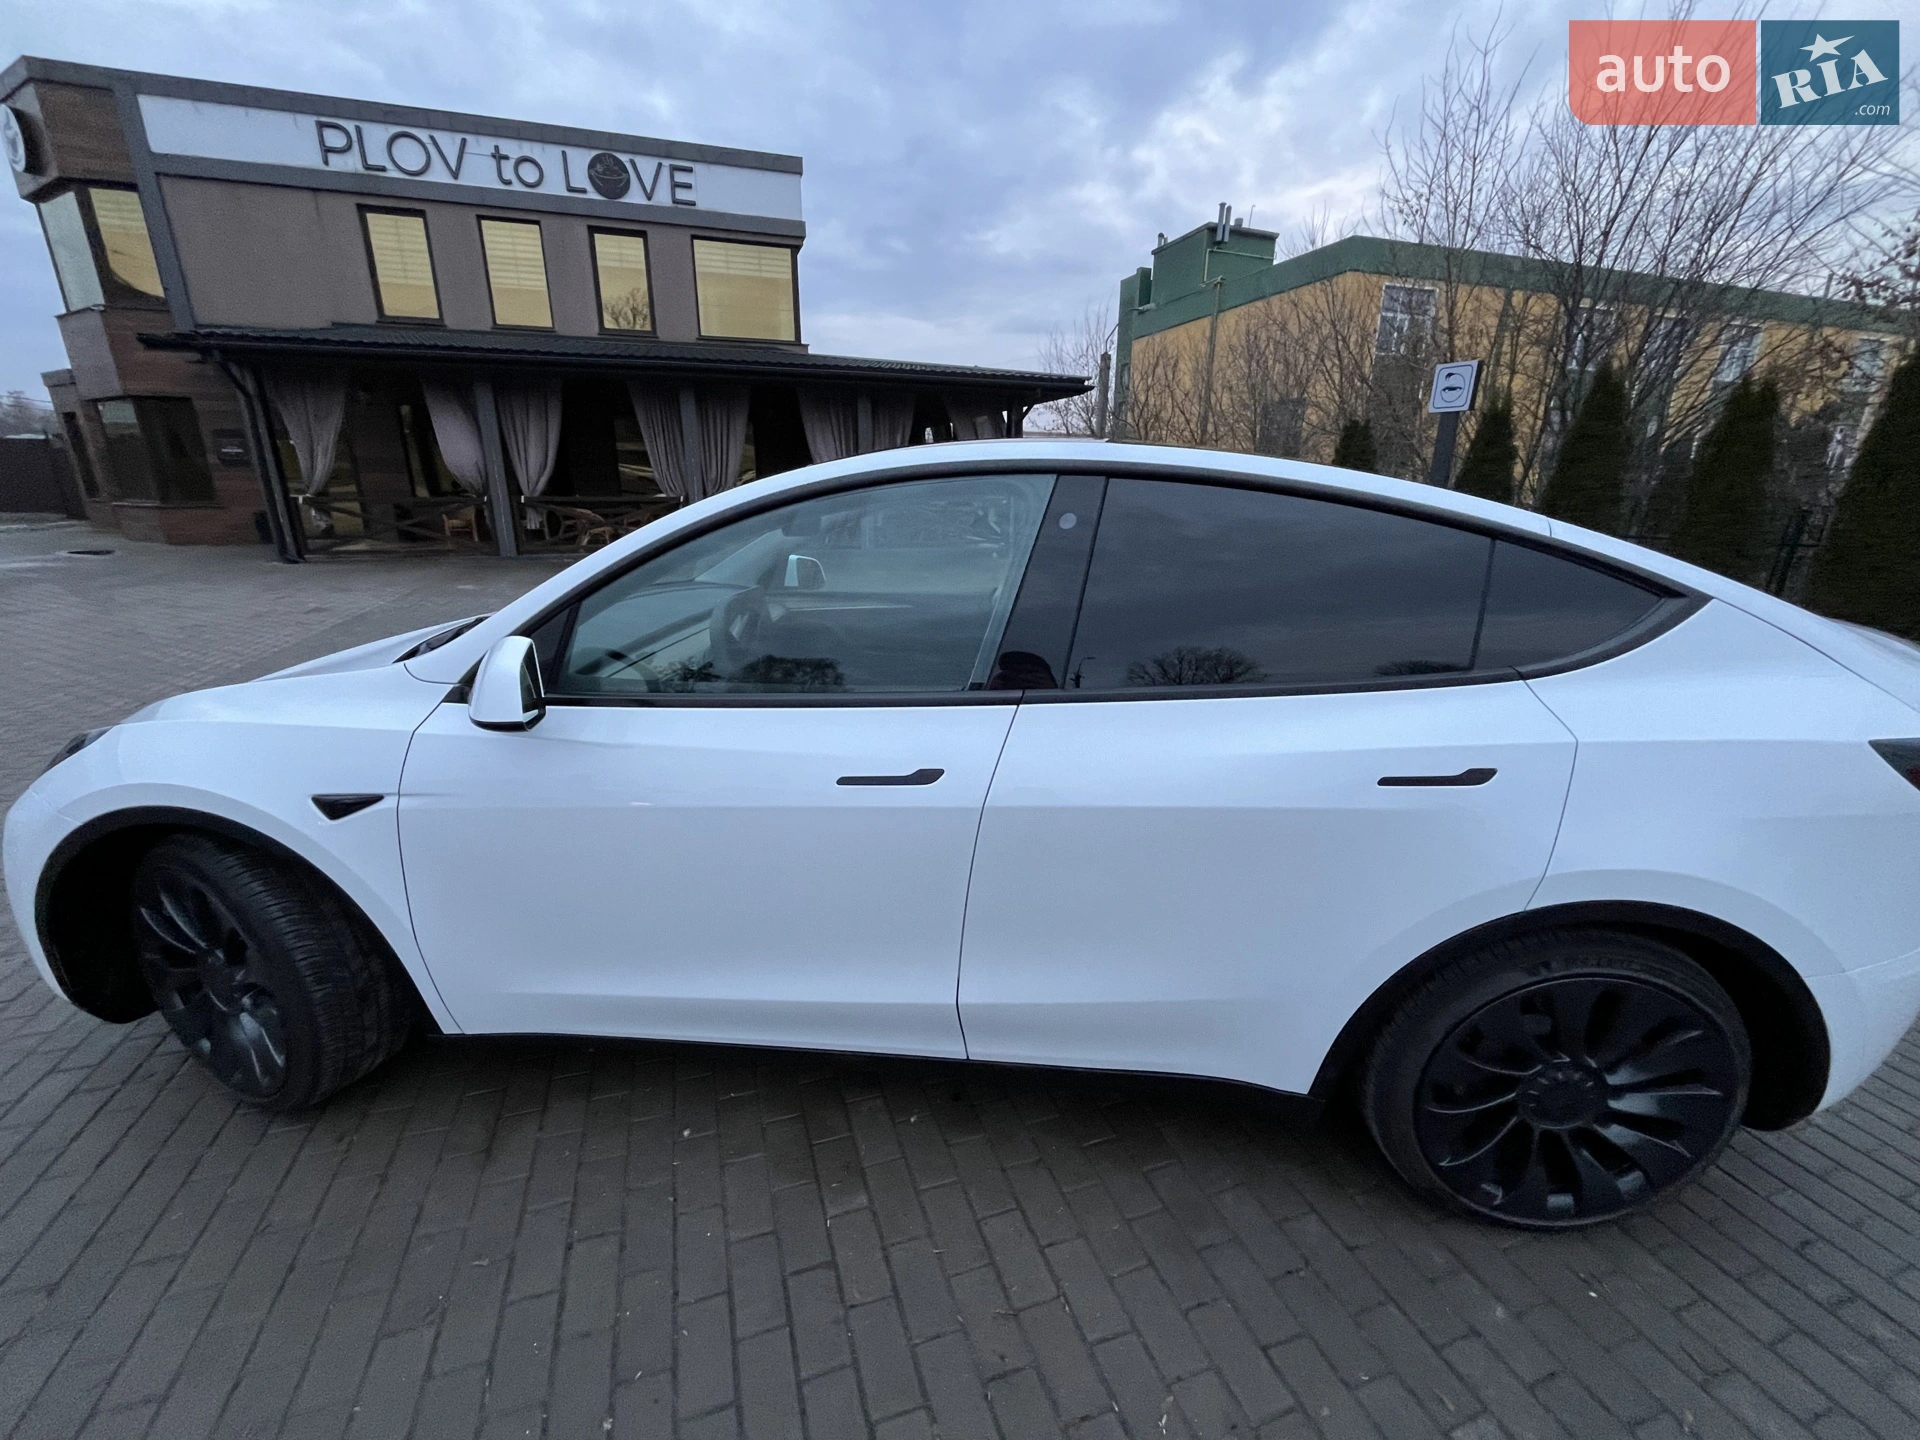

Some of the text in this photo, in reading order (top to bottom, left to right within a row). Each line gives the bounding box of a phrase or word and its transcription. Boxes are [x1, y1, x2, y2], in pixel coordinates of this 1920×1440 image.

[315, 120, 697, 207] PLOV to LOVE
